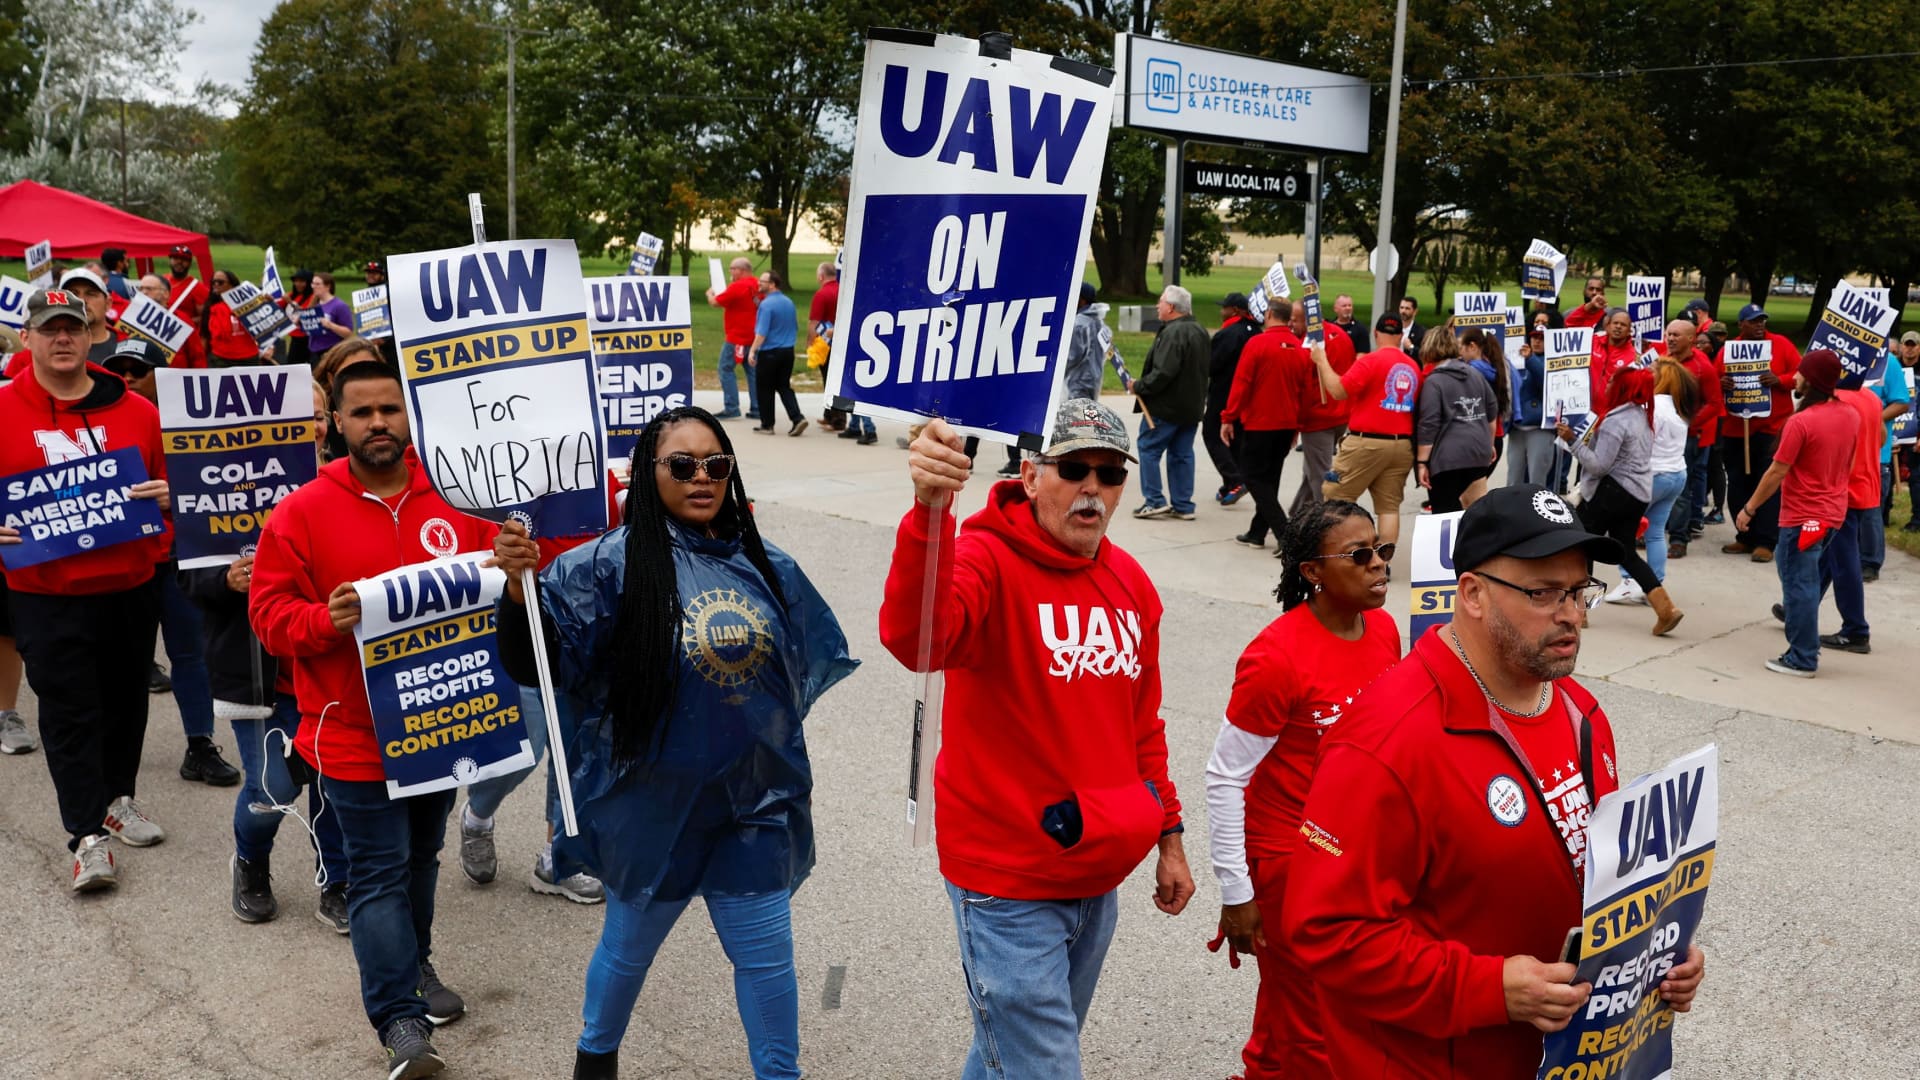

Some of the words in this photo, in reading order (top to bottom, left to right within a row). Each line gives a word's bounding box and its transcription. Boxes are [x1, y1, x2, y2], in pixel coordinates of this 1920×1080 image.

[1153, 72, 1175, 98] gm
[1188, 73, 1269, 99] CUSTOMER
[1276, 87, 1312, 106] CARE
[1188, 92, 1197, 108] &
[1202, 95, 1297, 121] AFTERSALES
[880, 64, 1096, 185] UAW
[1197, 170, 1223, 187] UAW
[1225, 173, 1262, 190] LOCAL
[1263, 177, 1280, 192] 174
[29, 244, 47, 266] UAW
[927, 211, 1007, 295] ON
[229, 284, 258, 304] UAW
[358, 288, 380, 302] UAW
[420, 248, 547, 322] UAW
[1271, 267, 1287, 295] UAW
[1630, 282, 1661, 298] UAW
[46, 291, 69, 305] N
[592, 282, 671, 322] UAW
[1464, 295, 1497, 312] UAW
[1637, 303, 1651, 319] ON
[1839, 289, 1886, 328] UAW
[136, 302, 182, 342] UAW
[1458, 317, 1487, 325] STAND
[1631, 316, 1661, 336] STRIKE
[1826, 313, 1860, 337] STAND
[1863, 331, 1879, 344] UP
[415, 334, 520, 372] STAND
[532, 326, 577, 351] UP
[659, 332, 685, 347] UP
[855, 296, 1057, 388] STRIKE
[1554, 331, 1583, 353] UAW
[1732, 344, 1763, 360] UAW
[1827, 334, 1860, 358] COLA
[600, 363, 672, 393] END
[1549, 359, 1572, 369] STAND
[1576, 358, 1588, 366] UP
[1727, 364, 1753, 372] STAND
[1756, 362, 1768, 370] UP
[183, 373, 288, 419] UAW
[466, 381, 530, 430] For
[1733, 389, 1762, 397] RECORD
[33, 426, 107, 467] N
[172, 428, 262, 450] STAND
[271, 426, 306, 442] UP
[7, 459, 117, 500] SAVING
[200, 457, 286, 485] COLA
[434, 432, 598, 509] AMERICA
[54, 486, 82, 500] THE
[234, 482, 256, 491] AND
[4, 485, 133, 528] AMERICAN
[177, 492, 249, 513] FAIR
[30, 505, 125, 541] DREAM
[382, 561, 482, 623] UAW
[373, 624, 460, 662] STAND
[711, 624, 749, 647] UAW
[1038, 603, 1142, 653] UAW
[395, 650, 490, 690] RECORD
[1049, 645, 1142, 683] STRONG
[398, 669, 495, 711] PROFITS
[404, 692, 499, 734] RECORD
[385, 705, 520, 758] CONTRACTS
[1498, 792, 1516, 813] Strike
[1616, 766, 1704, 879] UAW
[1591, 883, 1672, 949] STAND
[1675, 860, 1704, 895] UP
[1594, 922, 1680, 989] RECORD
[1577, 988, 1662, 1056] RECORD
